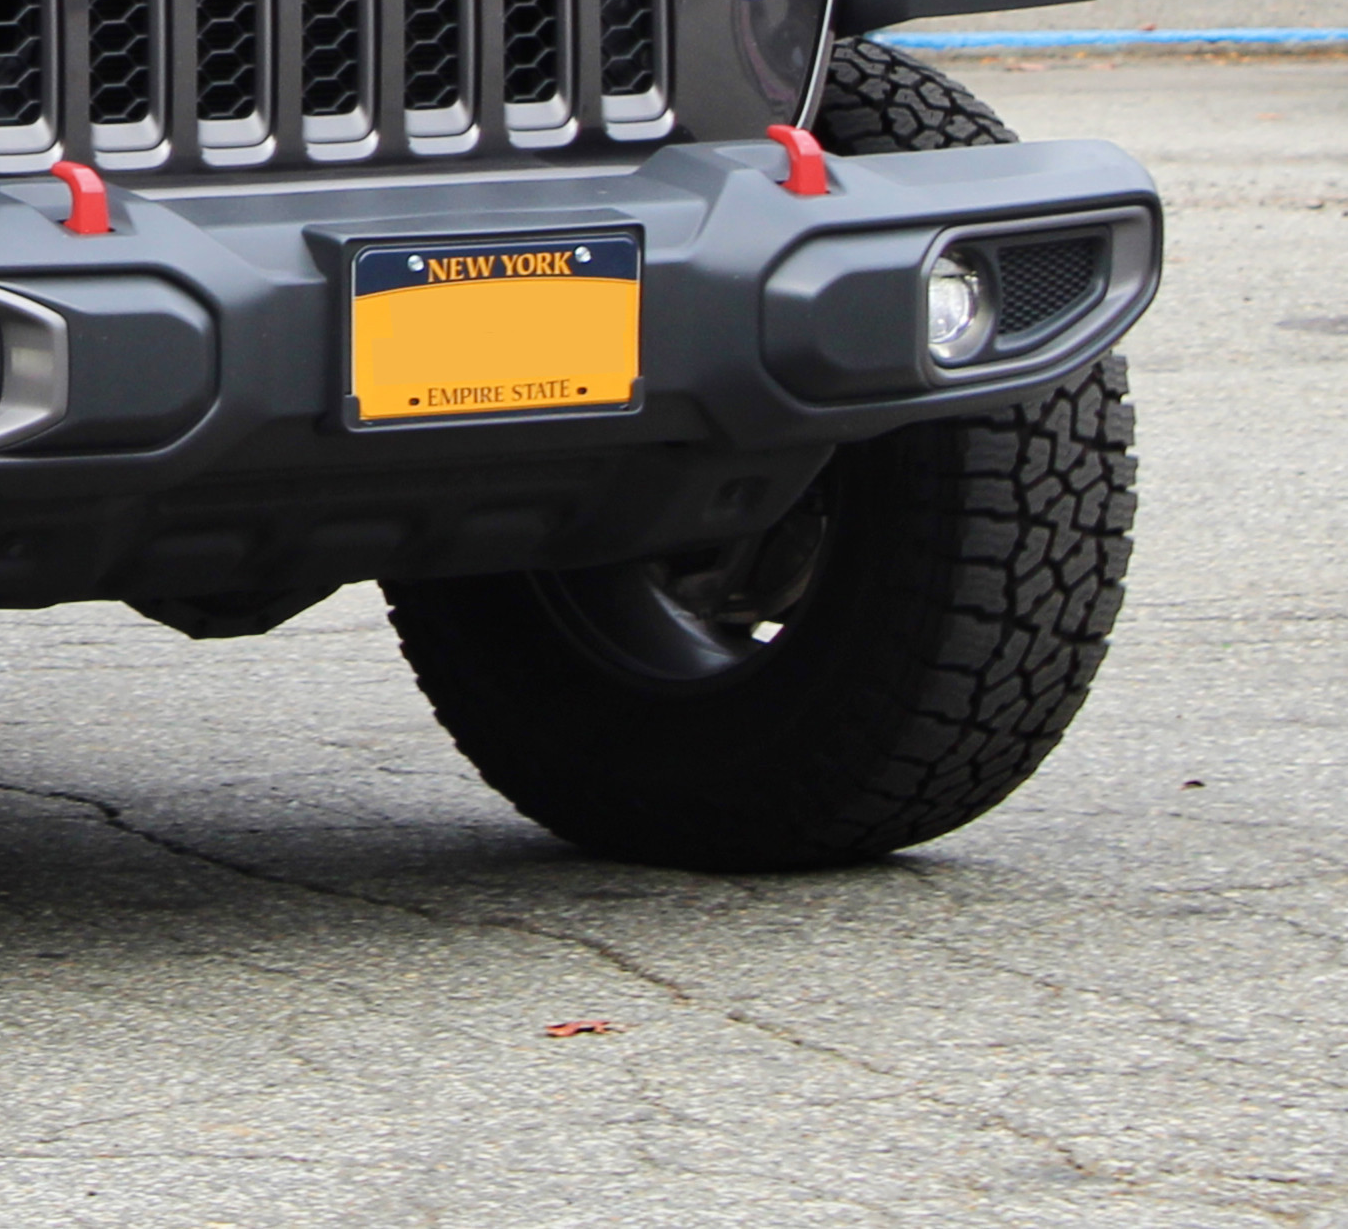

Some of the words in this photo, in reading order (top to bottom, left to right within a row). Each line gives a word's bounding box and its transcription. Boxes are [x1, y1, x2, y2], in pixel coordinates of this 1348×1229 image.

[427, 255, 495, 282] NEW
[500, 251, 573, 276] YORK
[427, 385, 506, 407] EMPIRE
[511, 379, 571, 402] STATE
